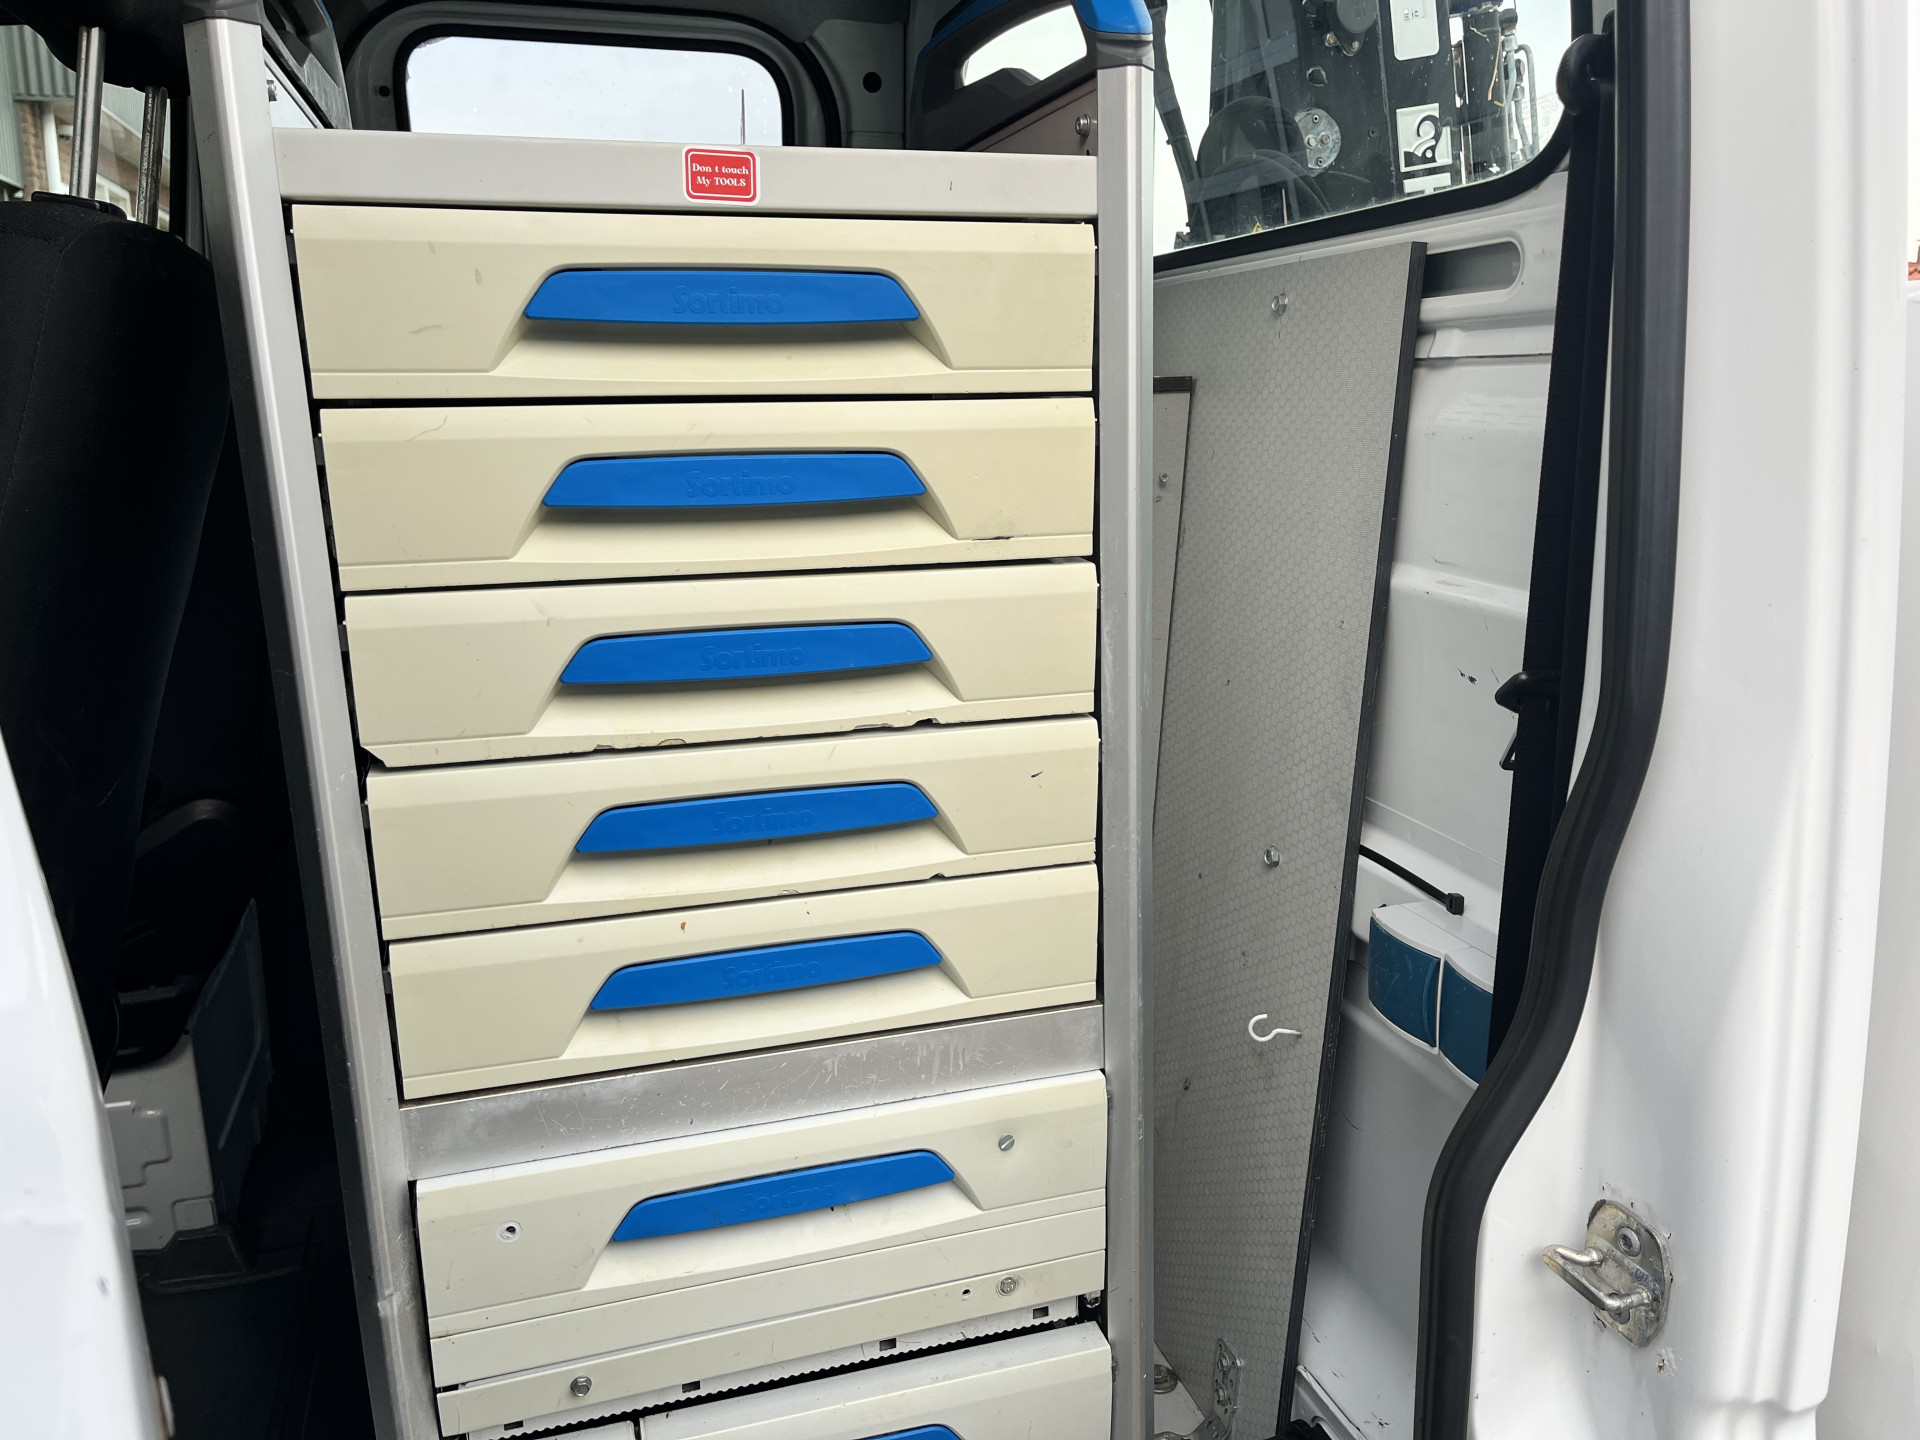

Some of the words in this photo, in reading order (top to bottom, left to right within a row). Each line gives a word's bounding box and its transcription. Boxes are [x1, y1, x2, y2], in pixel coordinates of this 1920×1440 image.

[696, 175, 712, 187] My
[714, 177, 746, 187] TOOLS
[722, 165, 749, 174] touch
[672, 285, 784, 315] Sortimo
[686, 470, 796, 498] Sortimo
[699, 643, 806, 672] Sortimo
[711, 807, 816, 837] Sortimo
[721, 960, 822, 990] Sortimo
[739, 1184, 837, 1216] Sortimo
